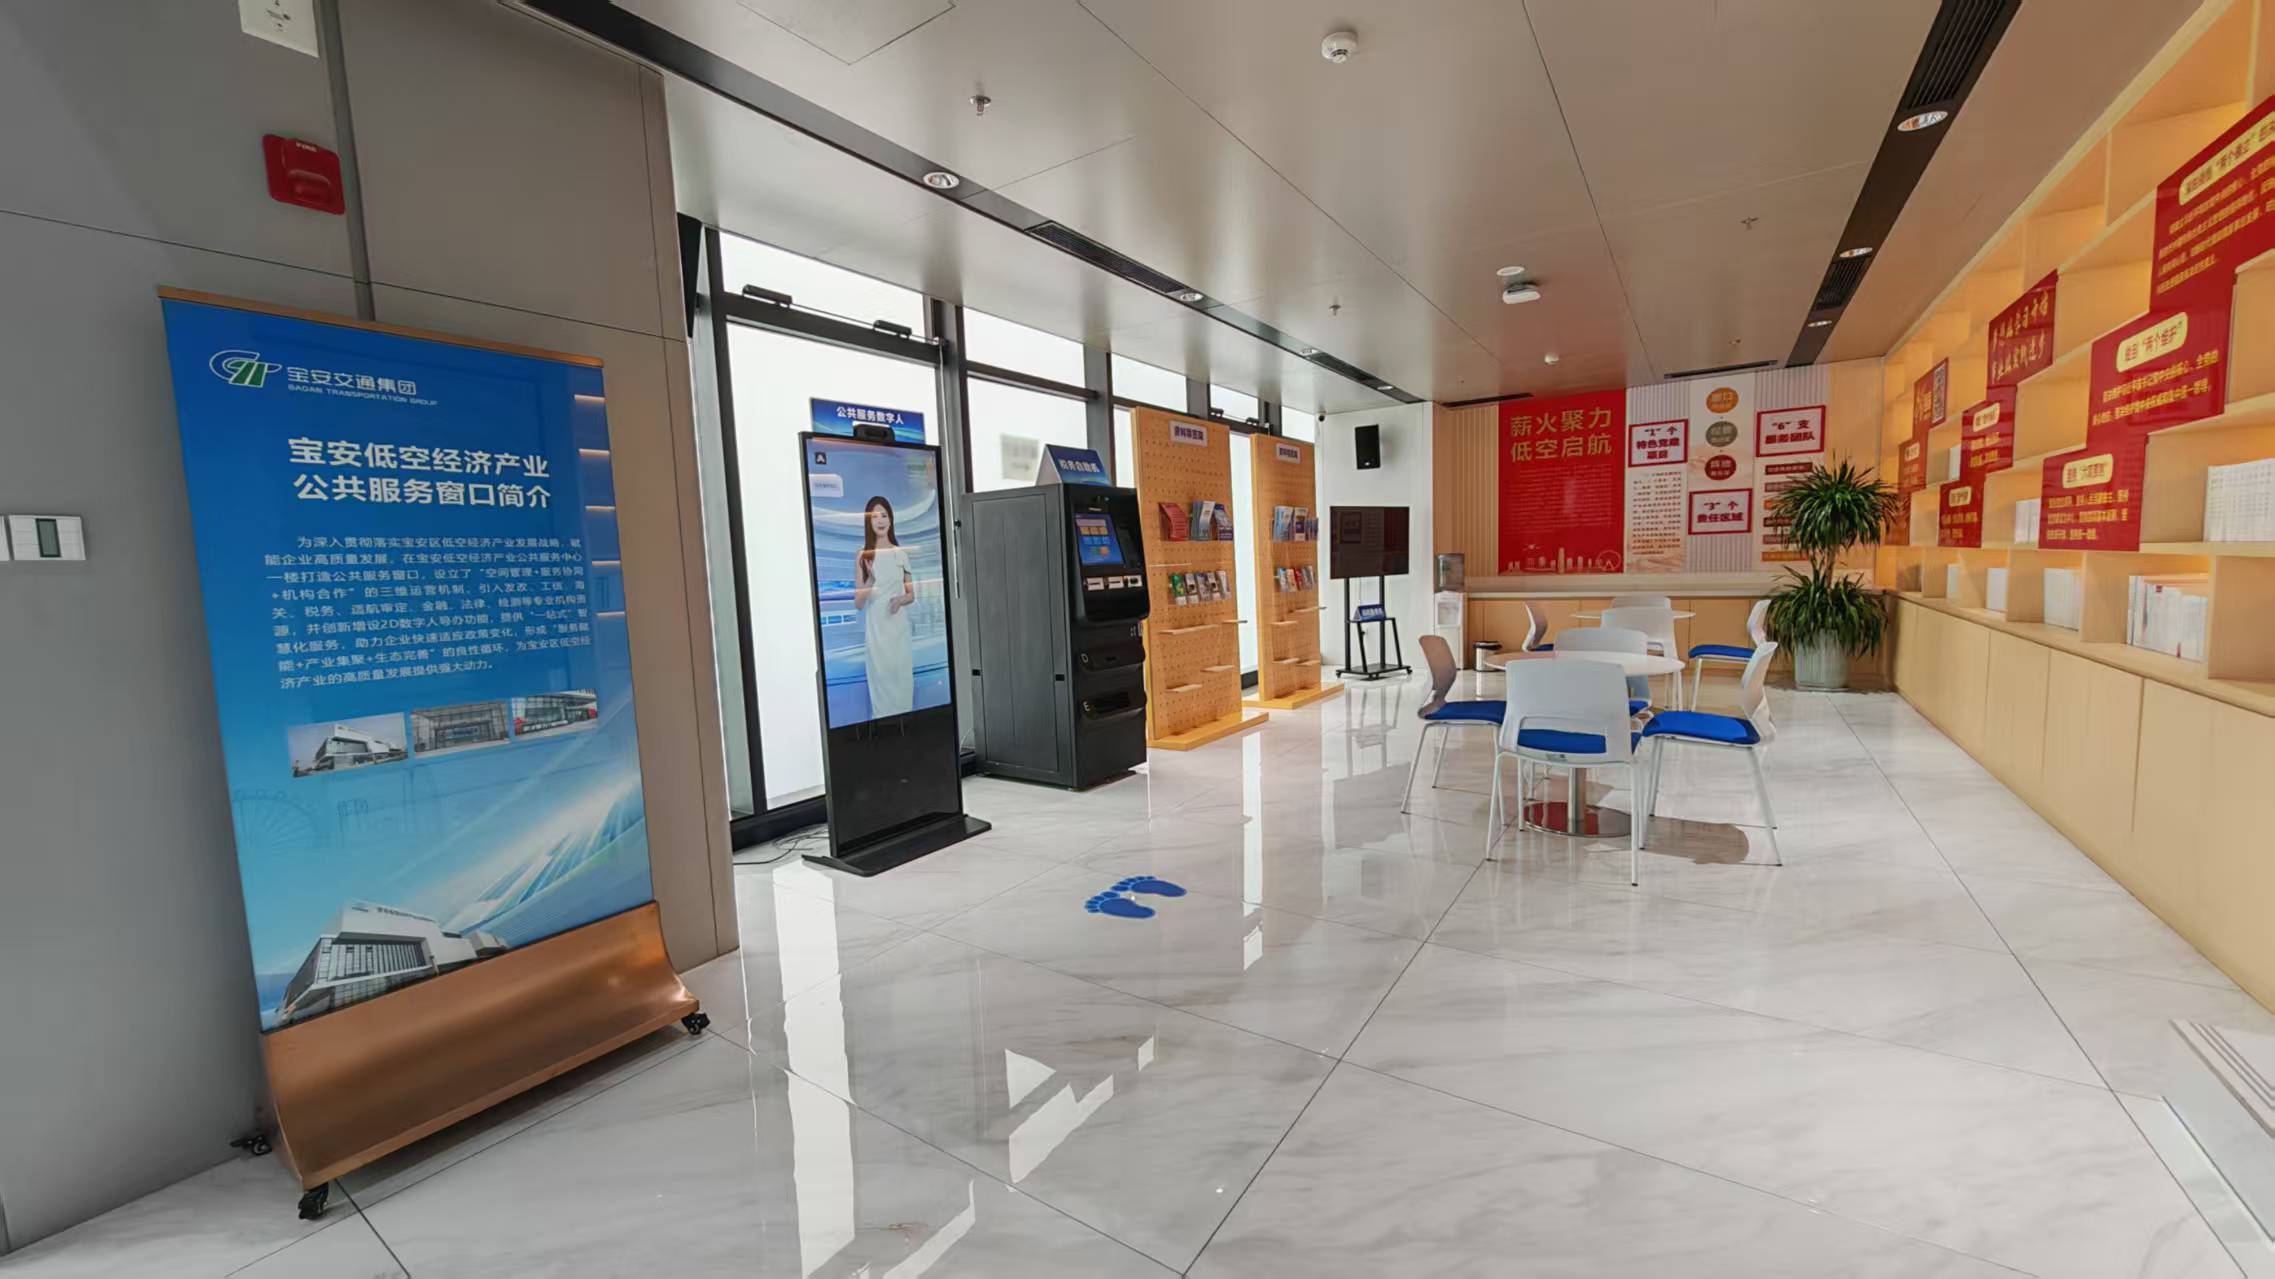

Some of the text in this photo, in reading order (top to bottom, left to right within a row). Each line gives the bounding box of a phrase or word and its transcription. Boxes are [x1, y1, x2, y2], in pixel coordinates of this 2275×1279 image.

[287, 367, 417, 395] 宝安交通集团
[327, 388, 407, 403] TRANSPORTATION
[409, 397, 438, 406] GROUP
[836, 406, 904, 425] 公共服务数字人
[1510, 407, 1612, 437] 薪火聚力
[287, 437, 550, 478] 宝安低空经济产业
[1510, 433, 1612, 463] 低空启航
[293, 473, 551, 509] 公共服务窗口简介
